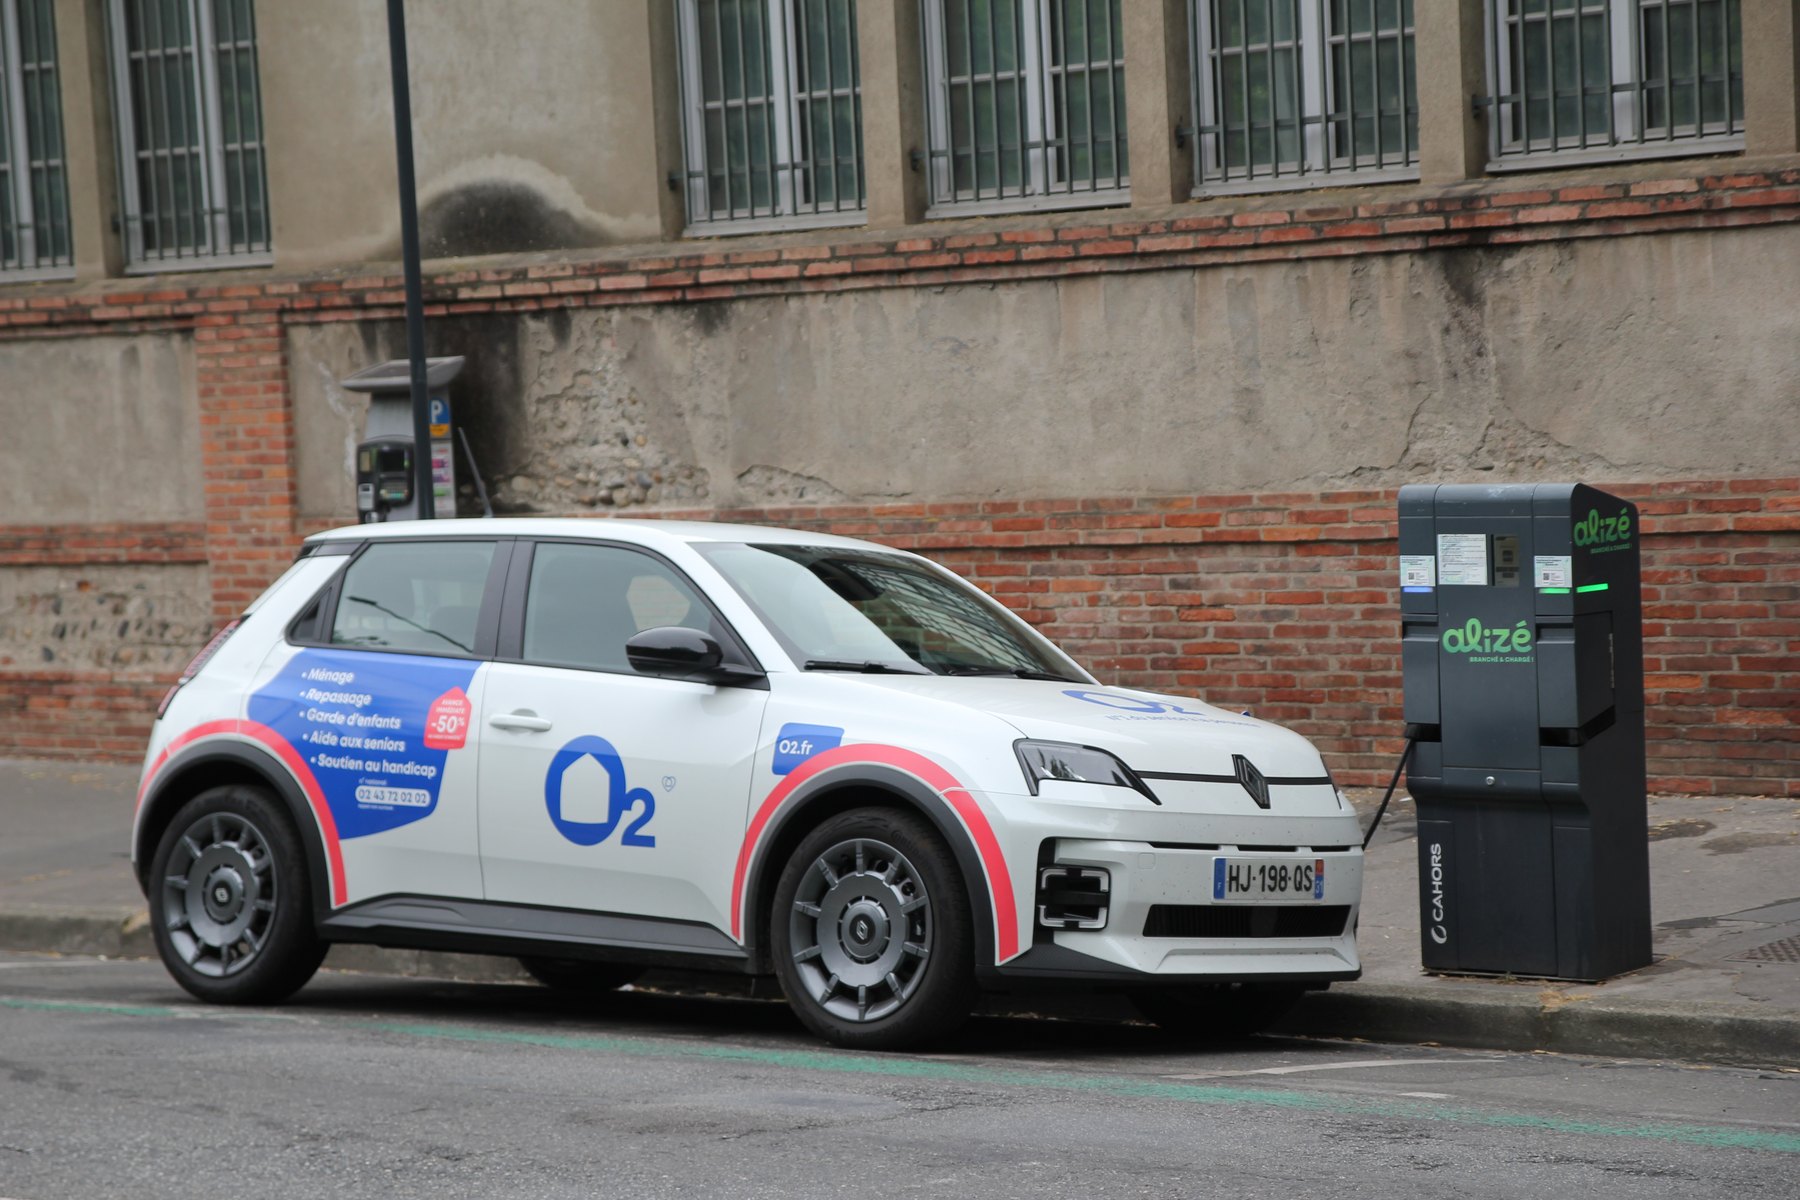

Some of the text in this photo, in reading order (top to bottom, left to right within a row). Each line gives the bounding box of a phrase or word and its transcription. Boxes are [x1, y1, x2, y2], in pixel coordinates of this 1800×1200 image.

[430, 399, 443, 424] P
[1574, 507, 1631, 546] alizé
[1442, 617, 1533, 653] alizé
[307, 668, 354, 685] Ménage
[305, 688, 372, 708] Repassage
[306, 708, 401, 729] Garde d'enfants
[309, 730, 406, 752] Aide aux seniors
[779, 739, 813, 755] O2.fr
[317, 753, 437, 779] Soutien au handicap
[358, 789, 427, 804] 02 43 72 02 02
[1430, 842, 1444, 922] CAHORS
